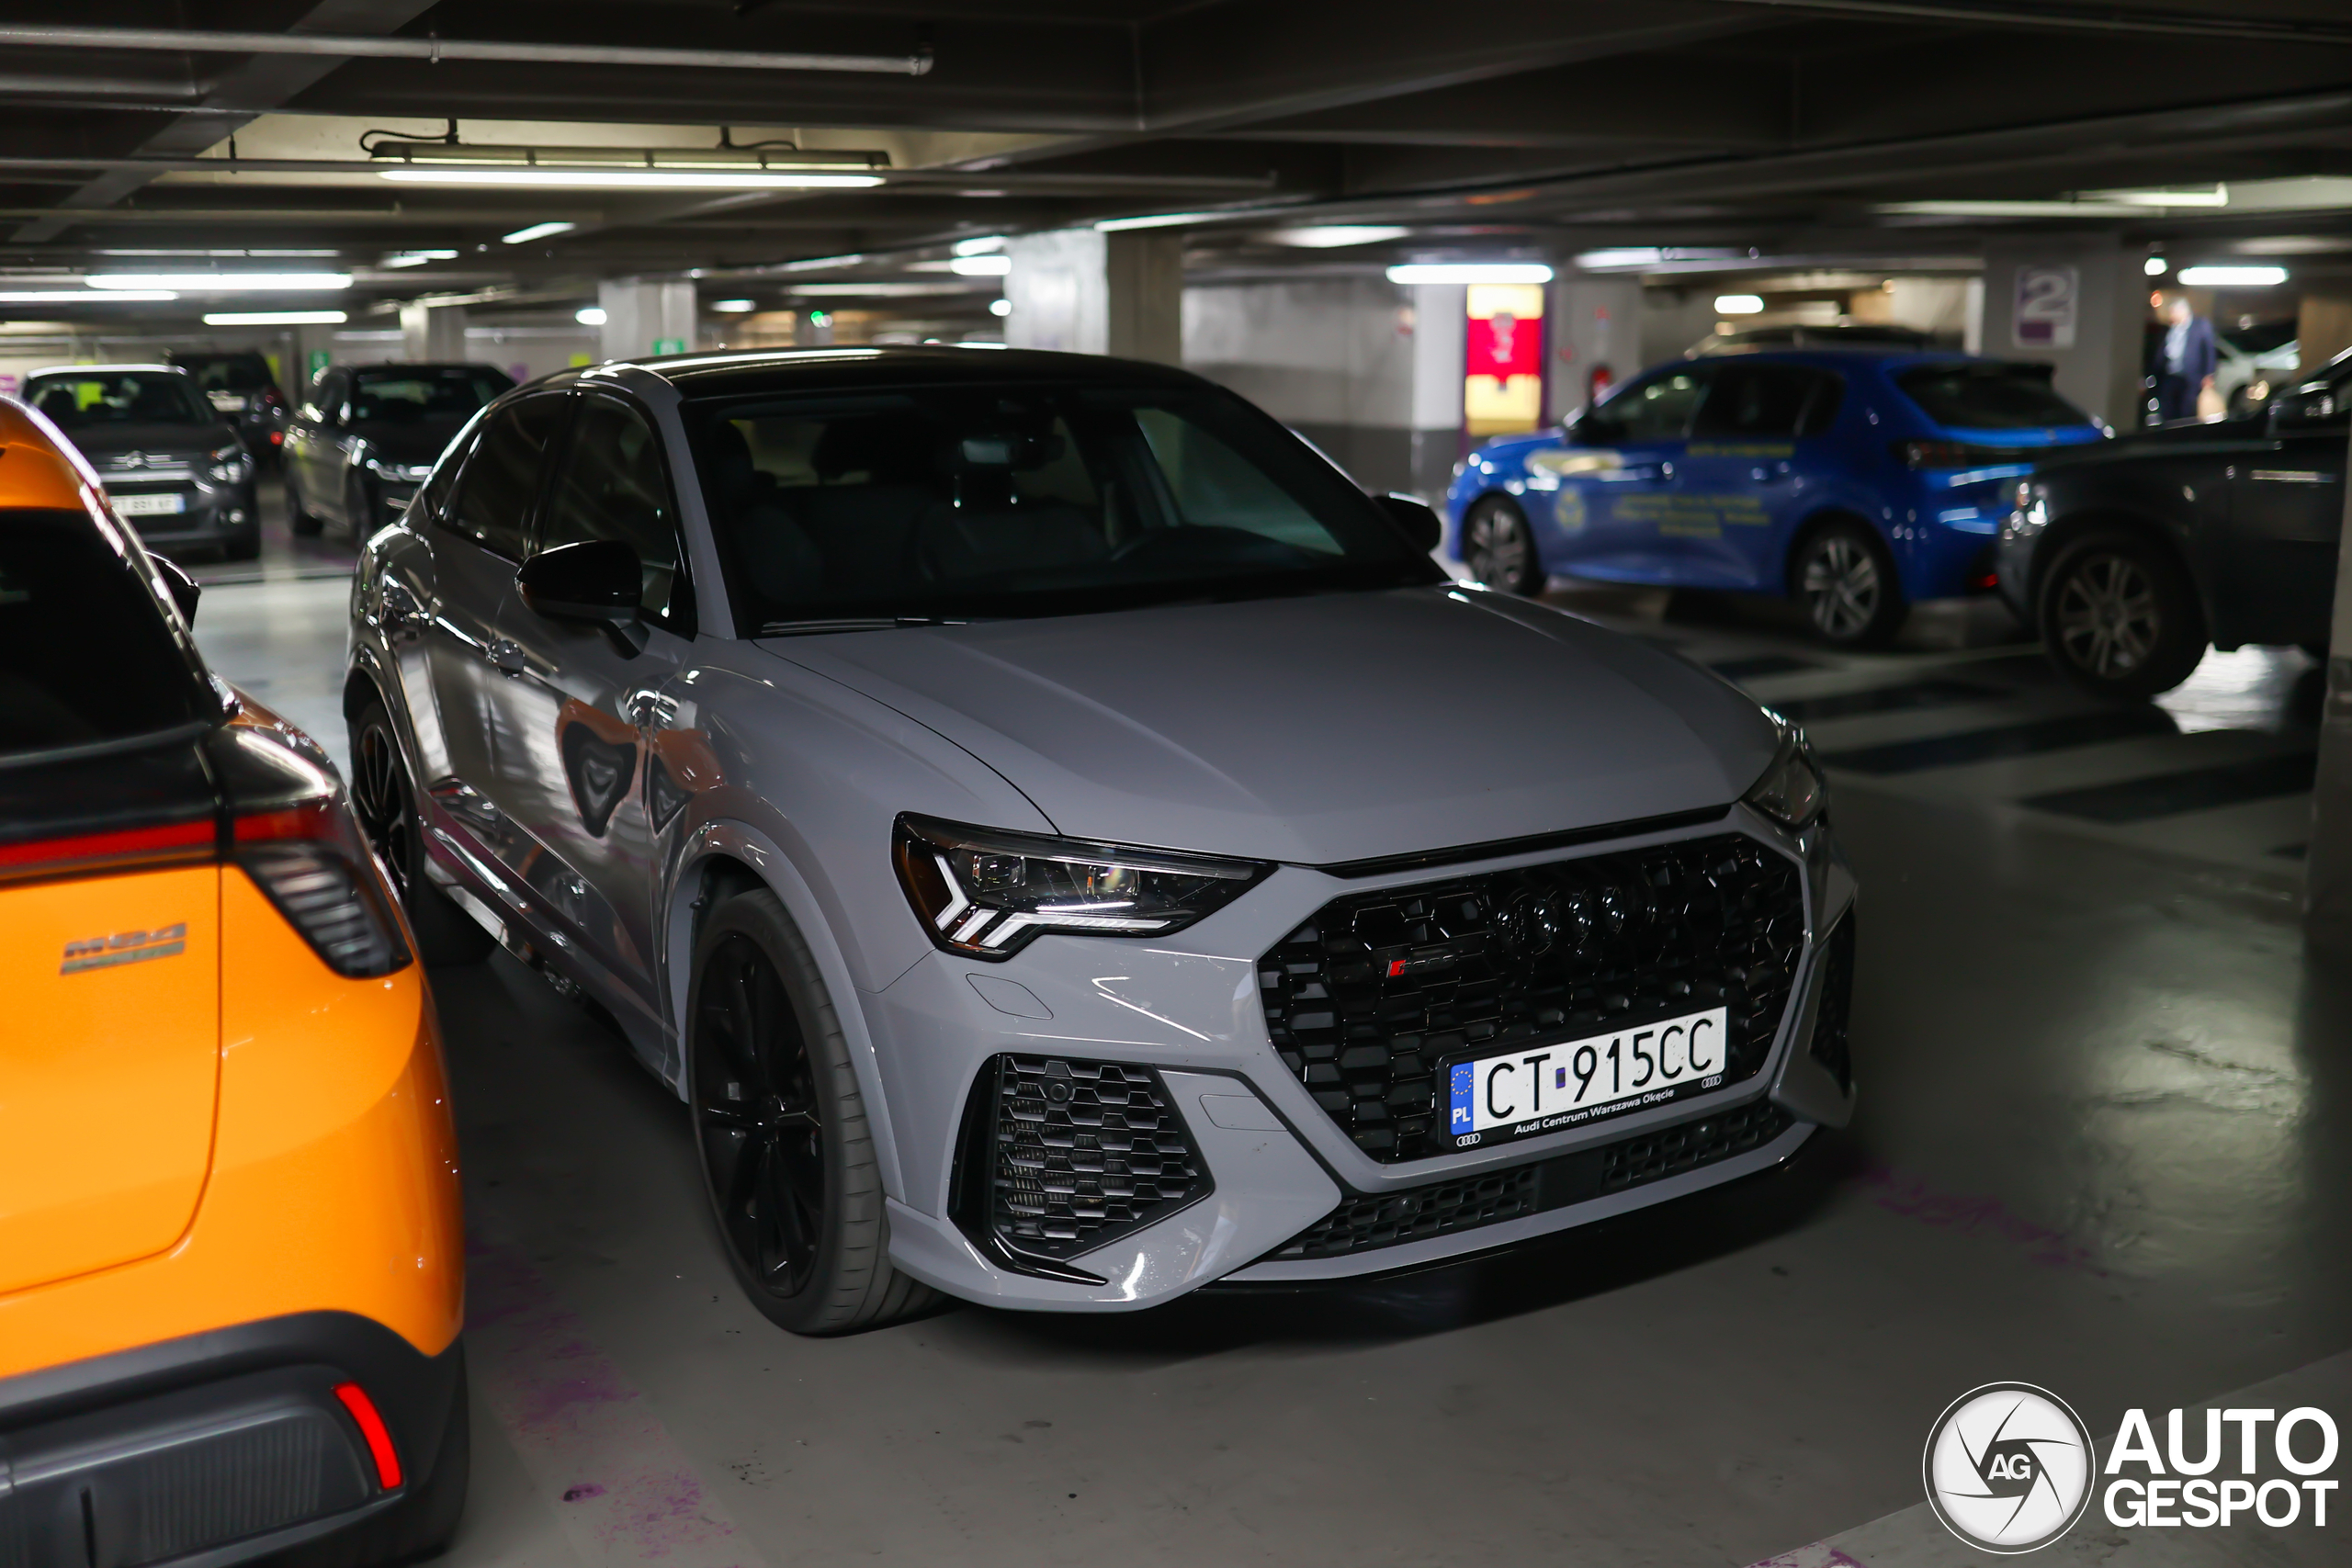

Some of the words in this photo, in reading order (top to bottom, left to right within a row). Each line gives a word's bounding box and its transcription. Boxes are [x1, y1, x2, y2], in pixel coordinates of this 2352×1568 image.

[2023, 275, 2068, 319] 2
[1487, 1054, 1550, 1119] CT
[1573, 1019, 1713, 1102] 915CC
[1453, 1107, 1470, 1124] PL
[1514, 1119, 1540, 1134] Audi
[1542, 1111, 1588, 1128] Centrum
[1589, 1097, 1641, 1116] Warszawa
[1643, 1089, 1674, 1104] Okęcie
